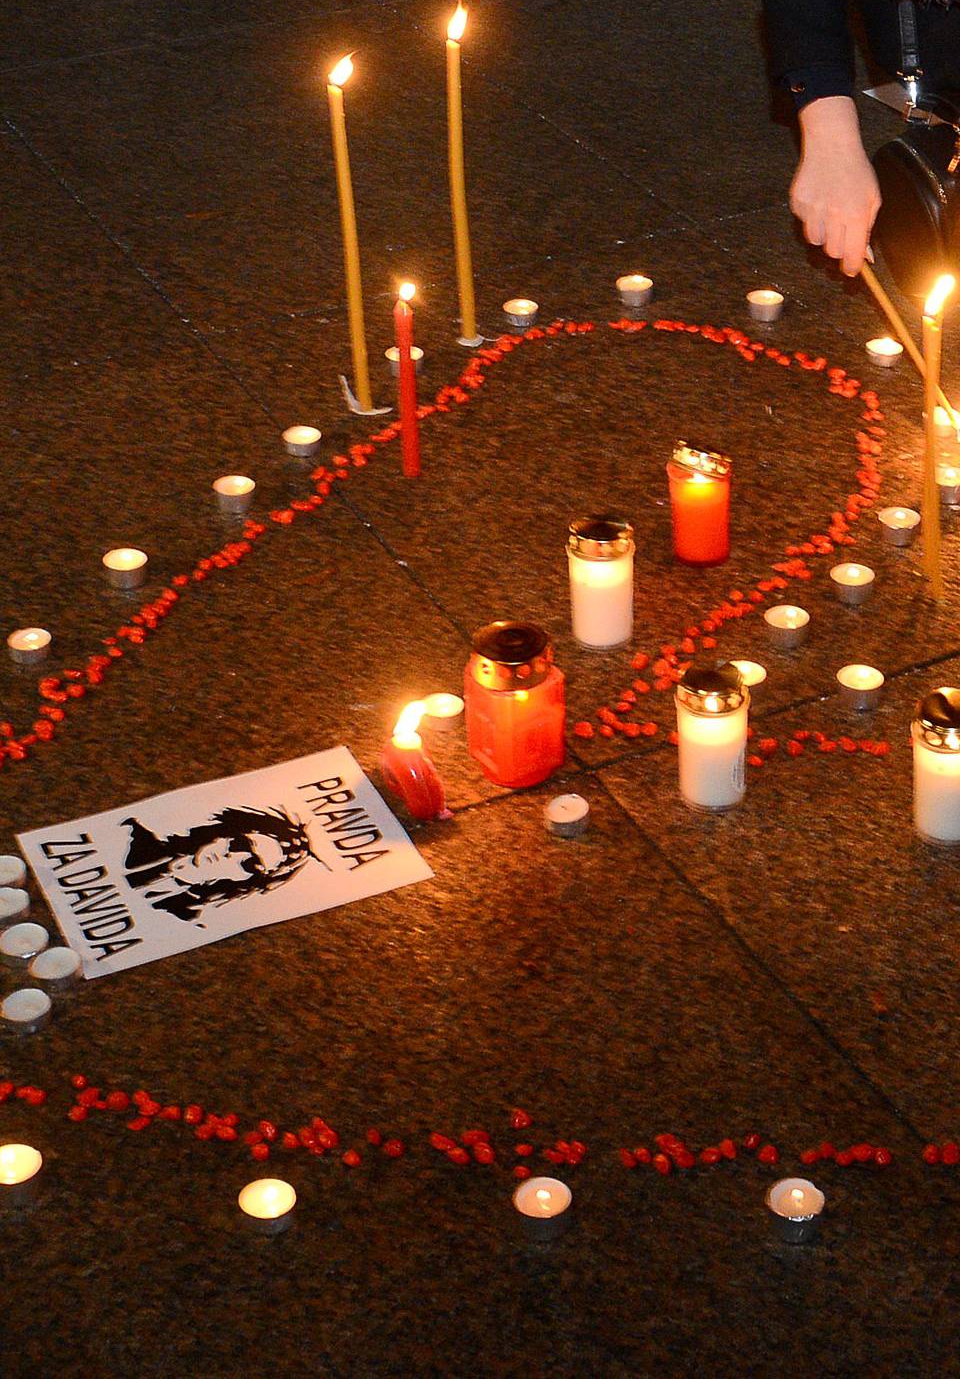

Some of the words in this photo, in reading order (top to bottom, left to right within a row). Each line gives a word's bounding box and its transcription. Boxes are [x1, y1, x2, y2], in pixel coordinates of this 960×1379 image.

[40, 833, 94, 873] ZA
[297, 775, 391, 871] PRAVDA
[61, 864, 143, 963] DAVIDA
